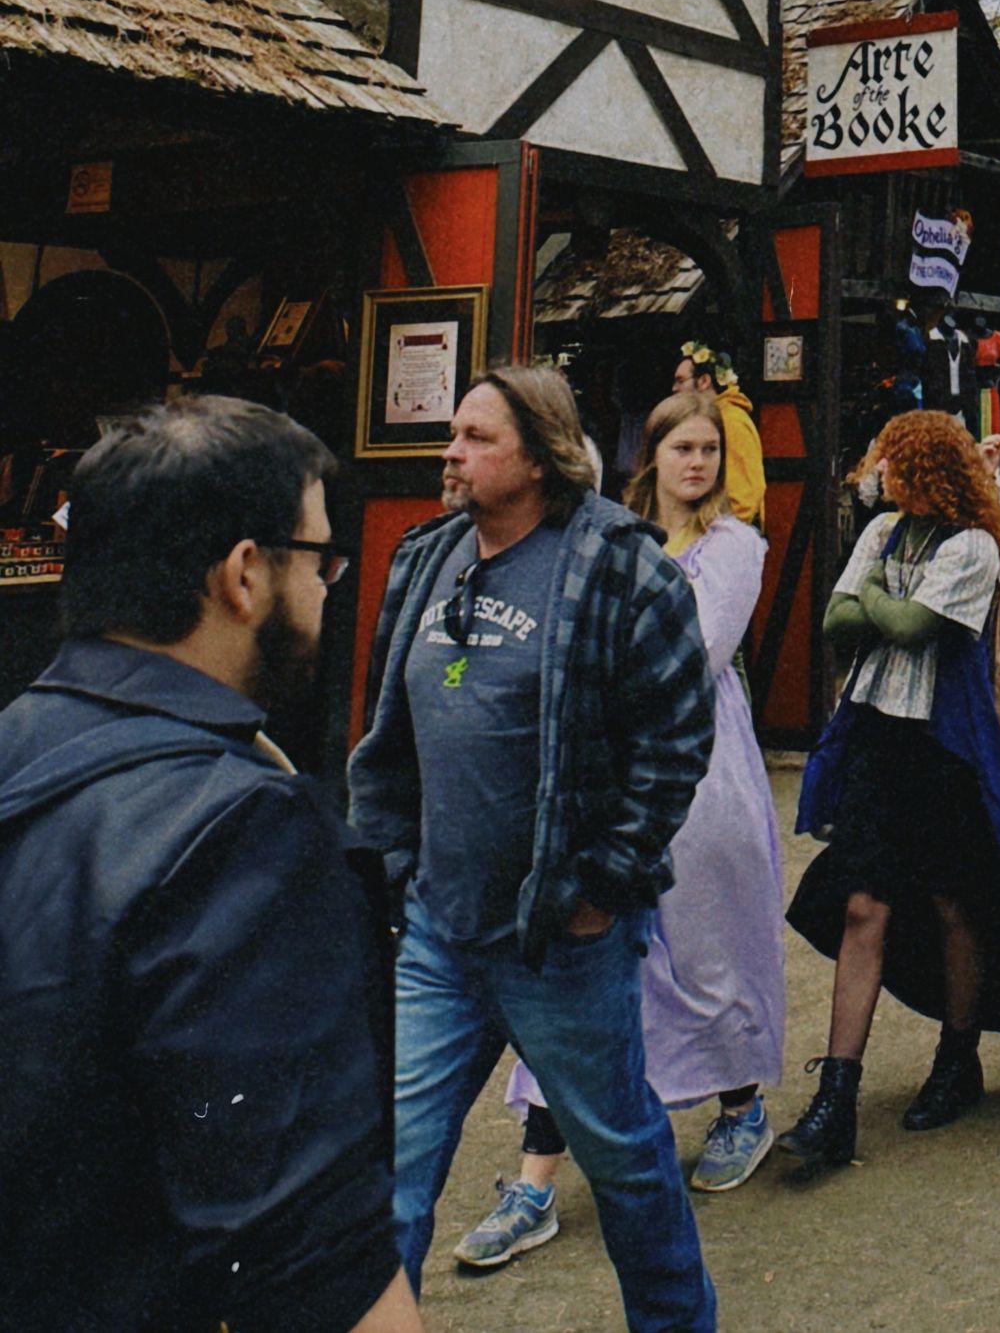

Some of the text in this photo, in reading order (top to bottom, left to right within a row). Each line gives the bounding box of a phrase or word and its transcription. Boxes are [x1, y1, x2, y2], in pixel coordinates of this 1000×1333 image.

[816, 40, 934, 103] Arte
[852, 84, 890, 111] of the
[811, 86, 947, 150] Booke
